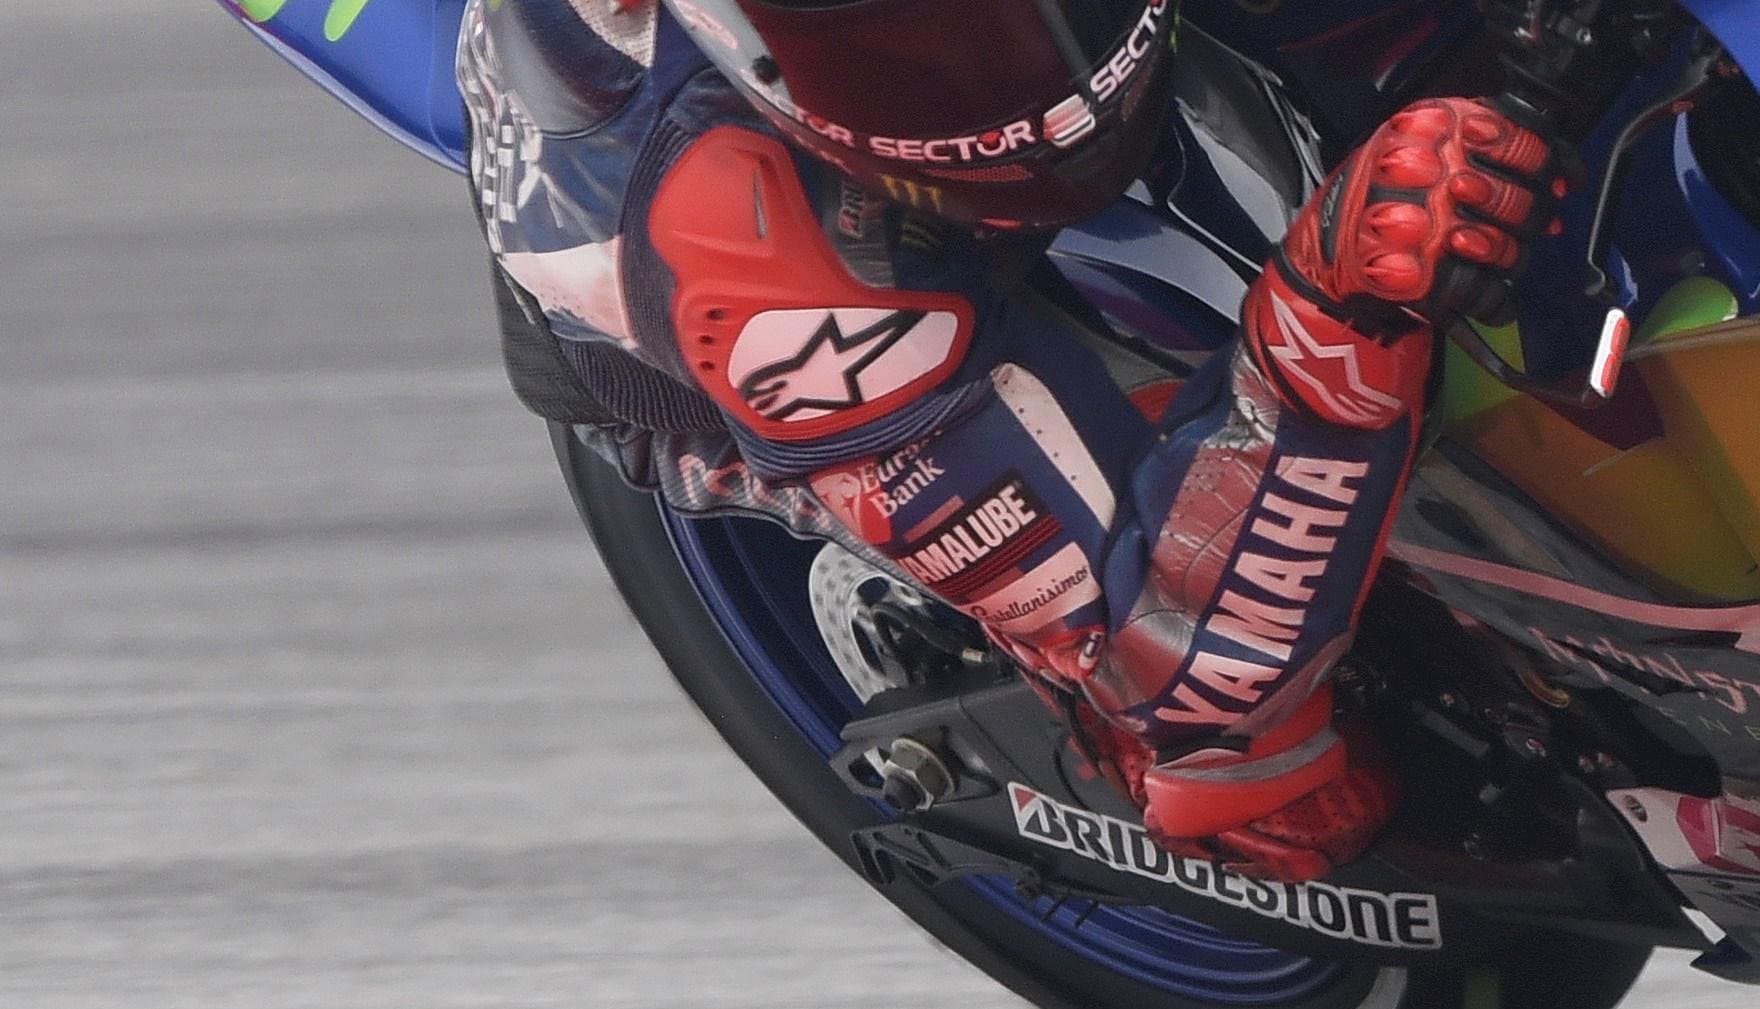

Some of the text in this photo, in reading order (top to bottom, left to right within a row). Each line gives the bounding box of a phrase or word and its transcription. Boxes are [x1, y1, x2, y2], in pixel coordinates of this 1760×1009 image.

[868, 119, 1037, 162] SECTOR
[869, 456, 946, 520] Bank
[1154, 454, 1369, 725] YAMAHA
